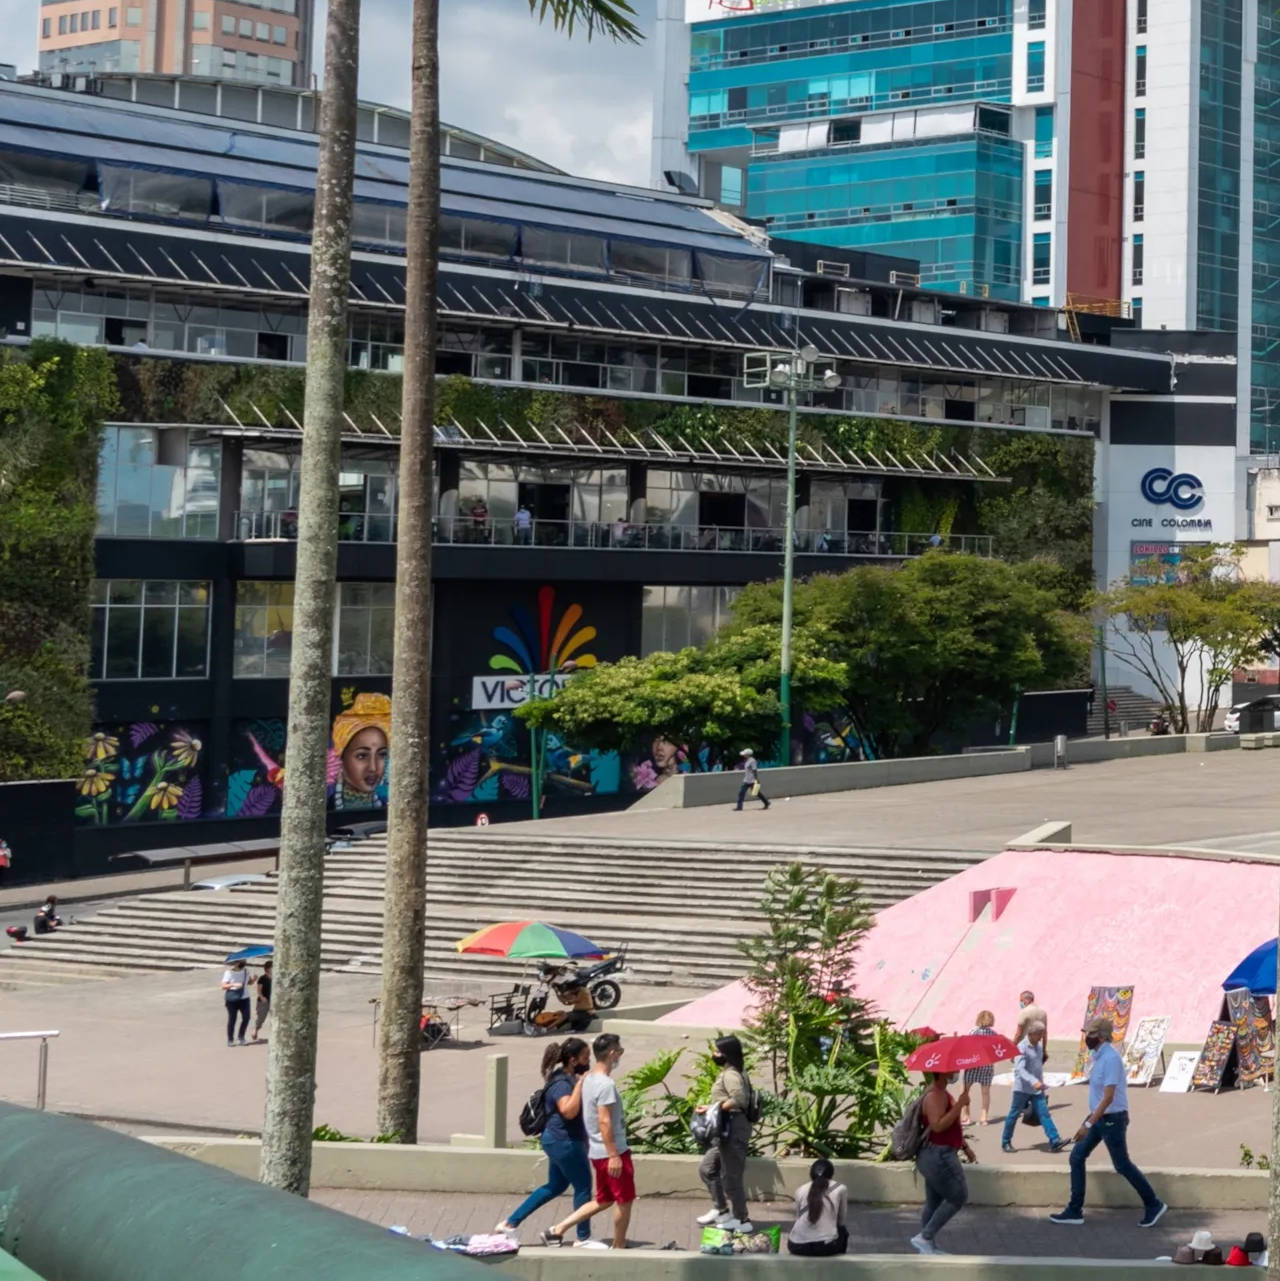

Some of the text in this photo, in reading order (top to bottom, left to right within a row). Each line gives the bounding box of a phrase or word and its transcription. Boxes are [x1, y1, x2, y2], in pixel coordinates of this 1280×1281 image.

[1131, 518, 1212, 528] CINE COLOMBIA
[956, 1056, 977, 1065] Claro
